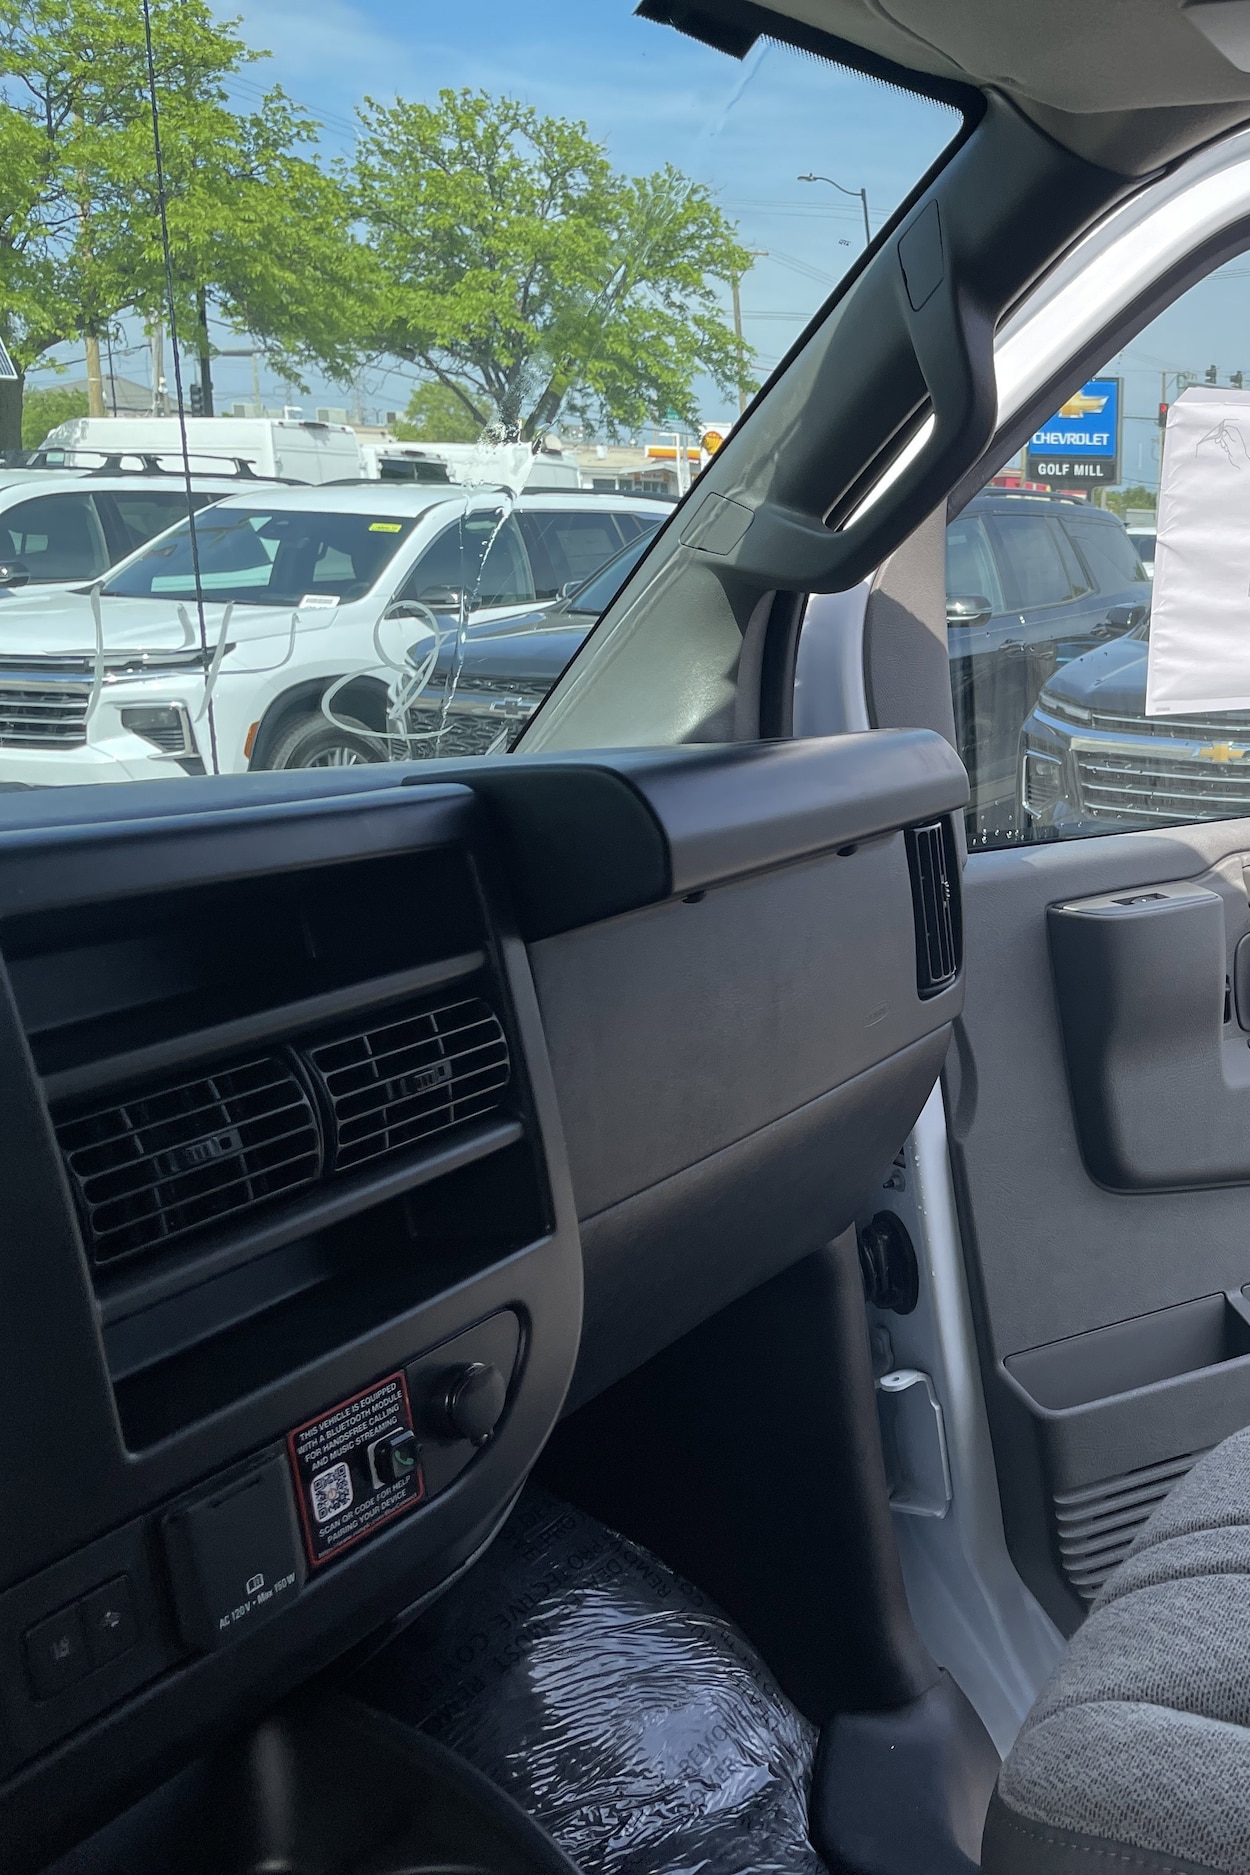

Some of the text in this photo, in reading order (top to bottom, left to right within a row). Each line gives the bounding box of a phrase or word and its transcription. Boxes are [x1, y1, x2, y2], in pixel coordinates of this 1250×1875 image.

[1032, 432, 1110, 446] CHEVROLET
[1037, 463, 1104, 477] GOLF MILL
[297, 1390, 403, 1455] WITH A BLUETOOTH MODULE
[299, 1382, 397, 1441] THIS VEHICLE IS EQUIPPED
[305, 1403, 400, 1463] FOR HANDSFREE CALLING
[311, 1416, 398, 1471] AND MUSIC STREAMING
[319, 1520, 341, 1538] SCAN
[354, 1500, 376, 1515] CODE
[376, 1486, 392, 1502] FOR
[392, 1475, 411, 1492] HELP
[327, 1488, 408, 1544] PAIRING YOUR DEVICE
[219, 1615, 231, 1630] AC
[257, 1589, 273, 1604] Max
